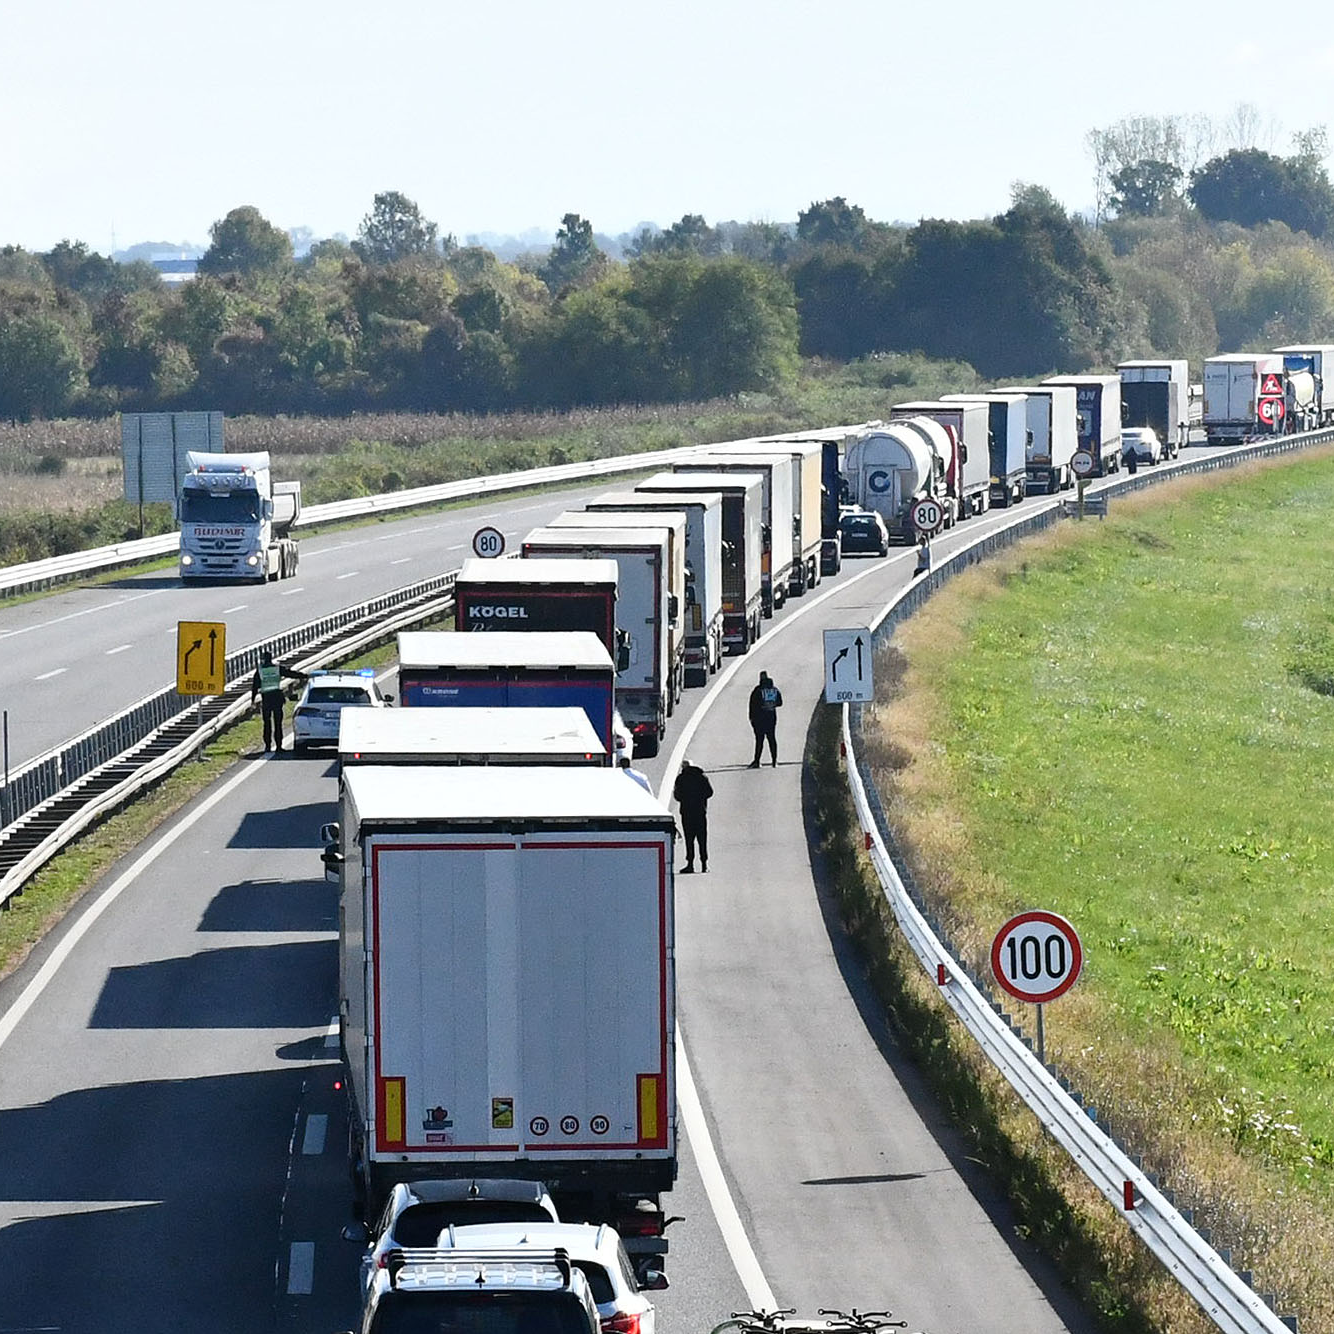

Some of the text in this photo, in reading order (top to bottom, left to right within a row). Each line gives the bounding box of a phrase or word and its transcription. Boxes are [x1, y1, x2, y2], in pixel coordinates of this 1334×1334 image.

[917, 507, 937, 524] 80
[480, 536, 497, 551] 80
[469, 606, 528, 618] KÖGEL
[1006, 934, 1066, 980] 100
[533, 1121, 545, 1131] 70
[564, 1120, 575, 1130] 80
[594, 1120, 605, 1130] 90
